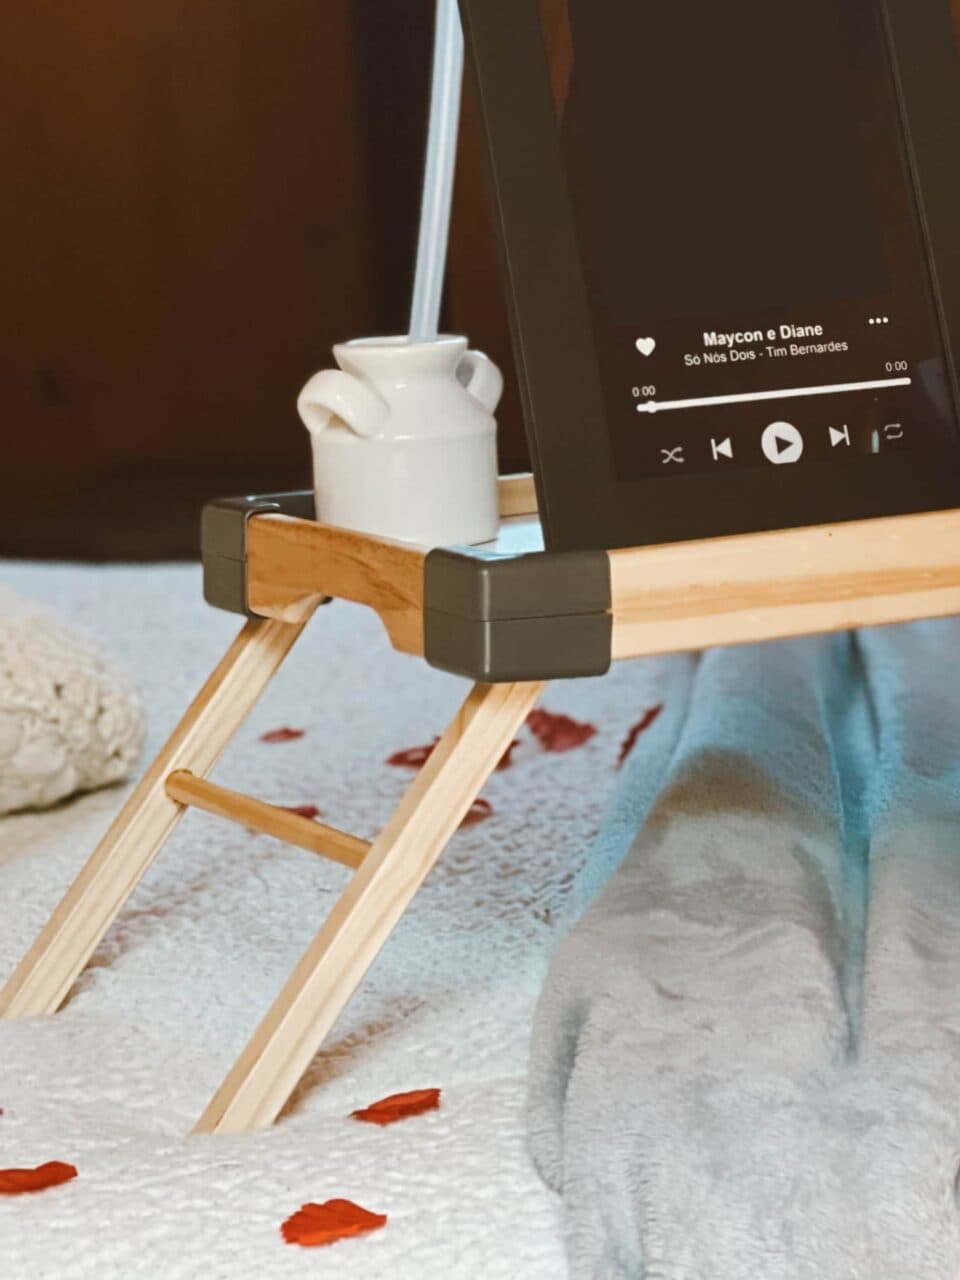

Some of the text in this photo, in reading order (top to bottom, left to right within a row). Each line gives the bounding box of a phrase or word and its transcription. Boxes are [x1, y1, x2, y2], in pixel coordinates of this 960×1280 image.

[703, 324, 823, 348] Maycon e Diane
[684, 353, 701, 366] Só
[703, 351, 727, 364] Nós
[729, 349, 756, 362] Dois
[766, 346, 788, 358] Tim
[790, 341, 849, 356] Bernardes
